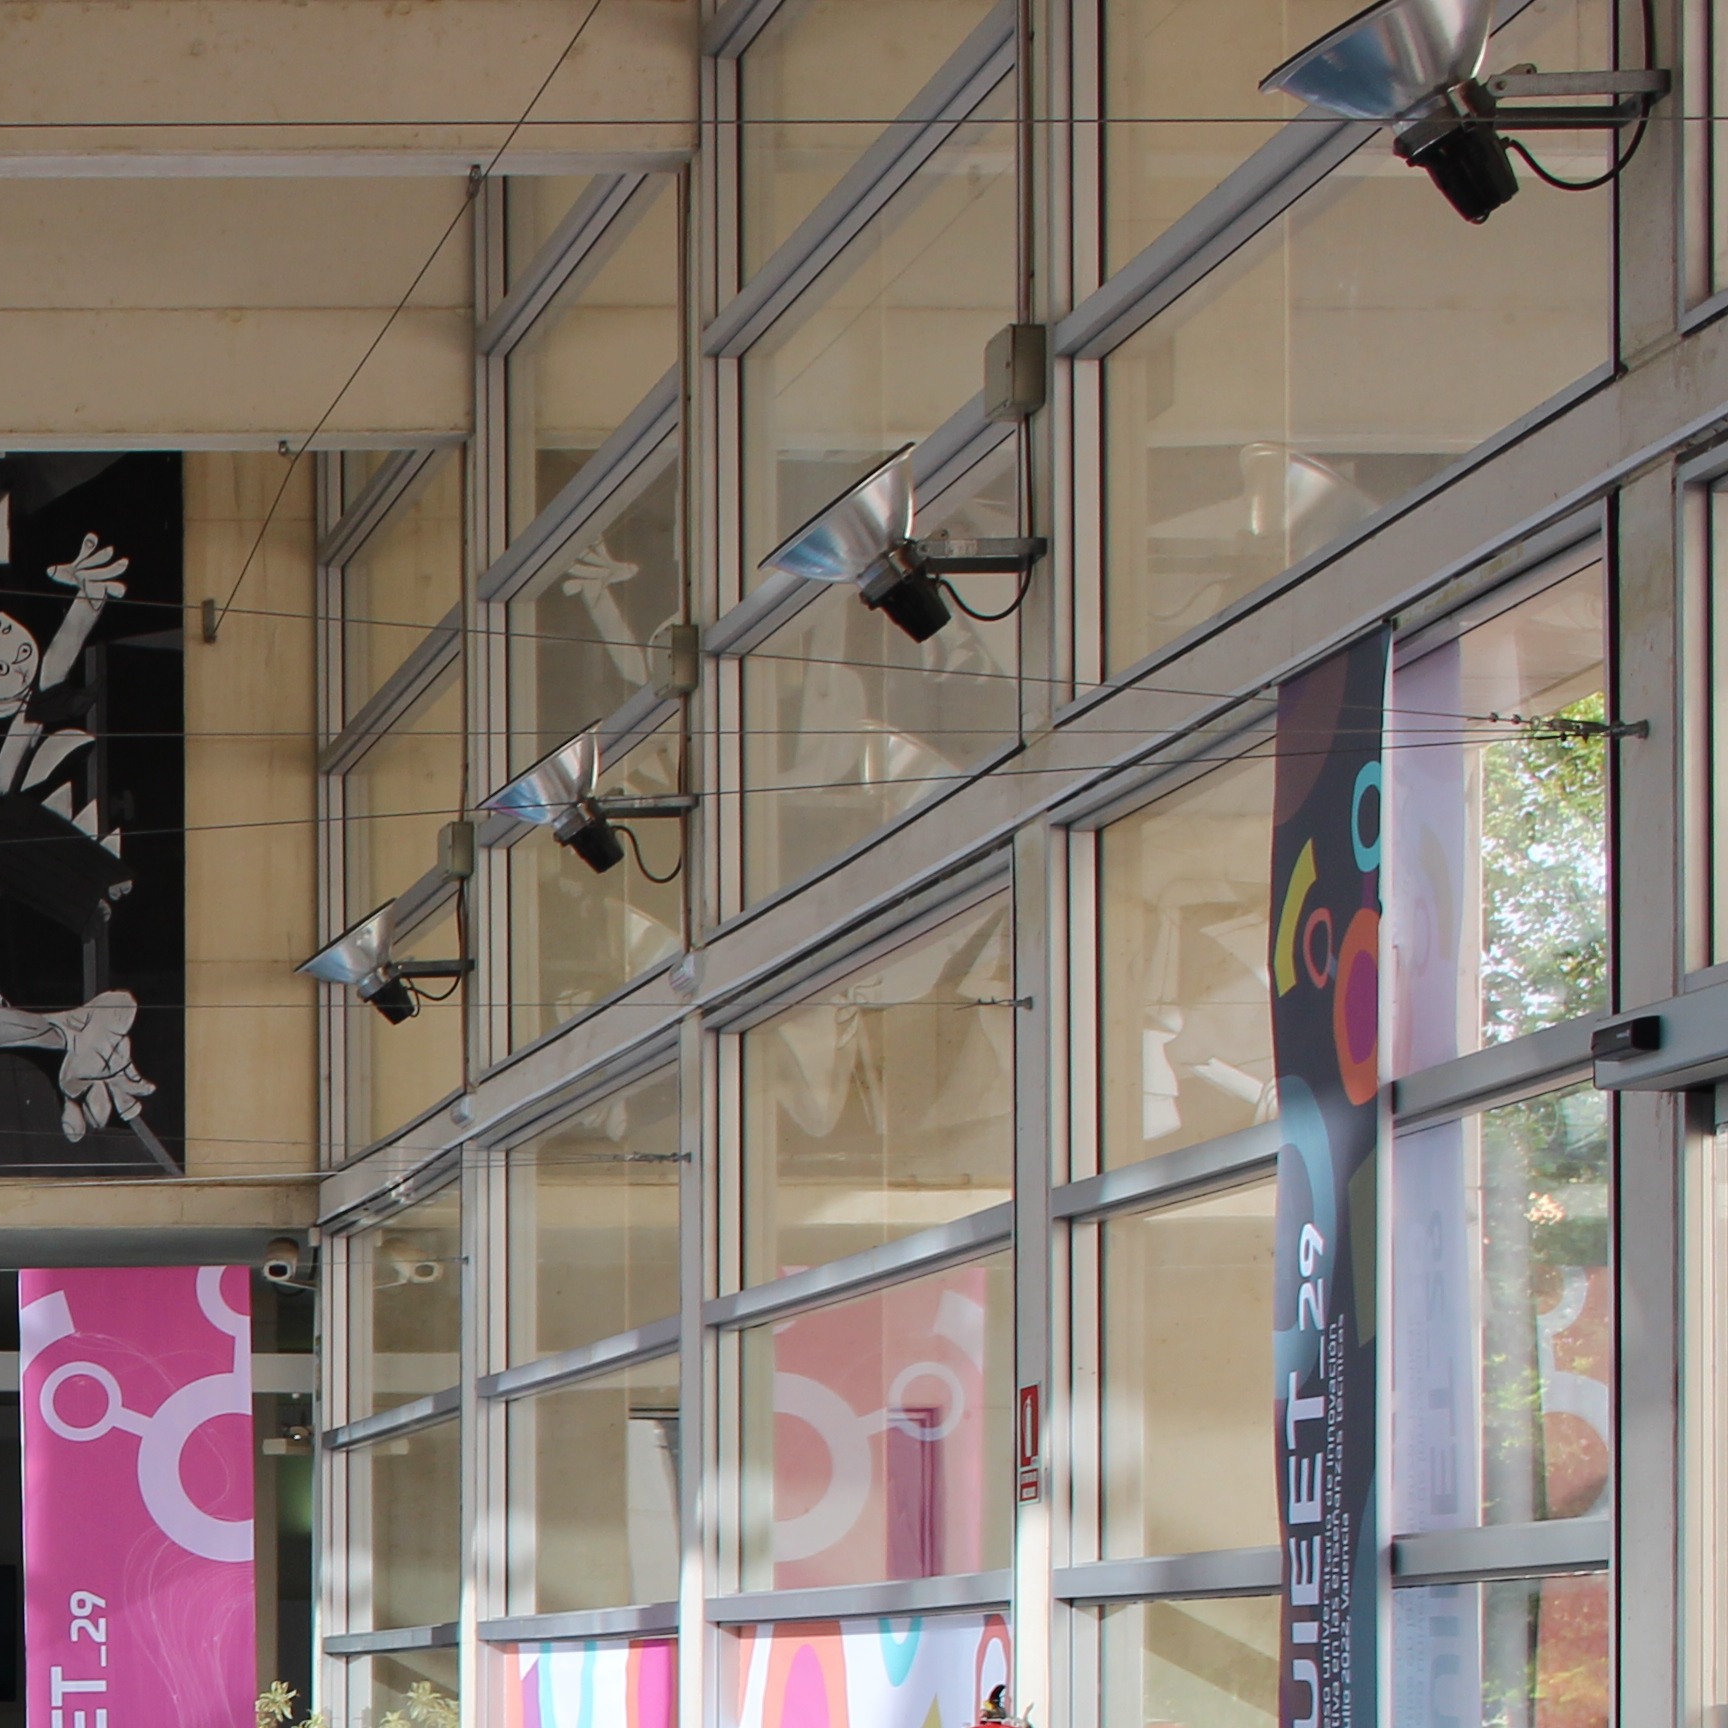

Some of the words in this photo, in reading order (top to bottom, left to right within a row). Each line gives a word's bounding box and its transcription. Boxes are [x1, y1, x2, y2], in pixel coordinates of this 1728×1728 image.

[1326, 1323, 1337, 1467] innovación
[1325, 1473, 1334, 1507] de
[1341, 1512, 1350, 1610] Valencia
[1322, 1514, 1333, 1679] universitario
[1330, 1597, 1341, 1634] las
[1331, 1641, 1341, 1673] en
